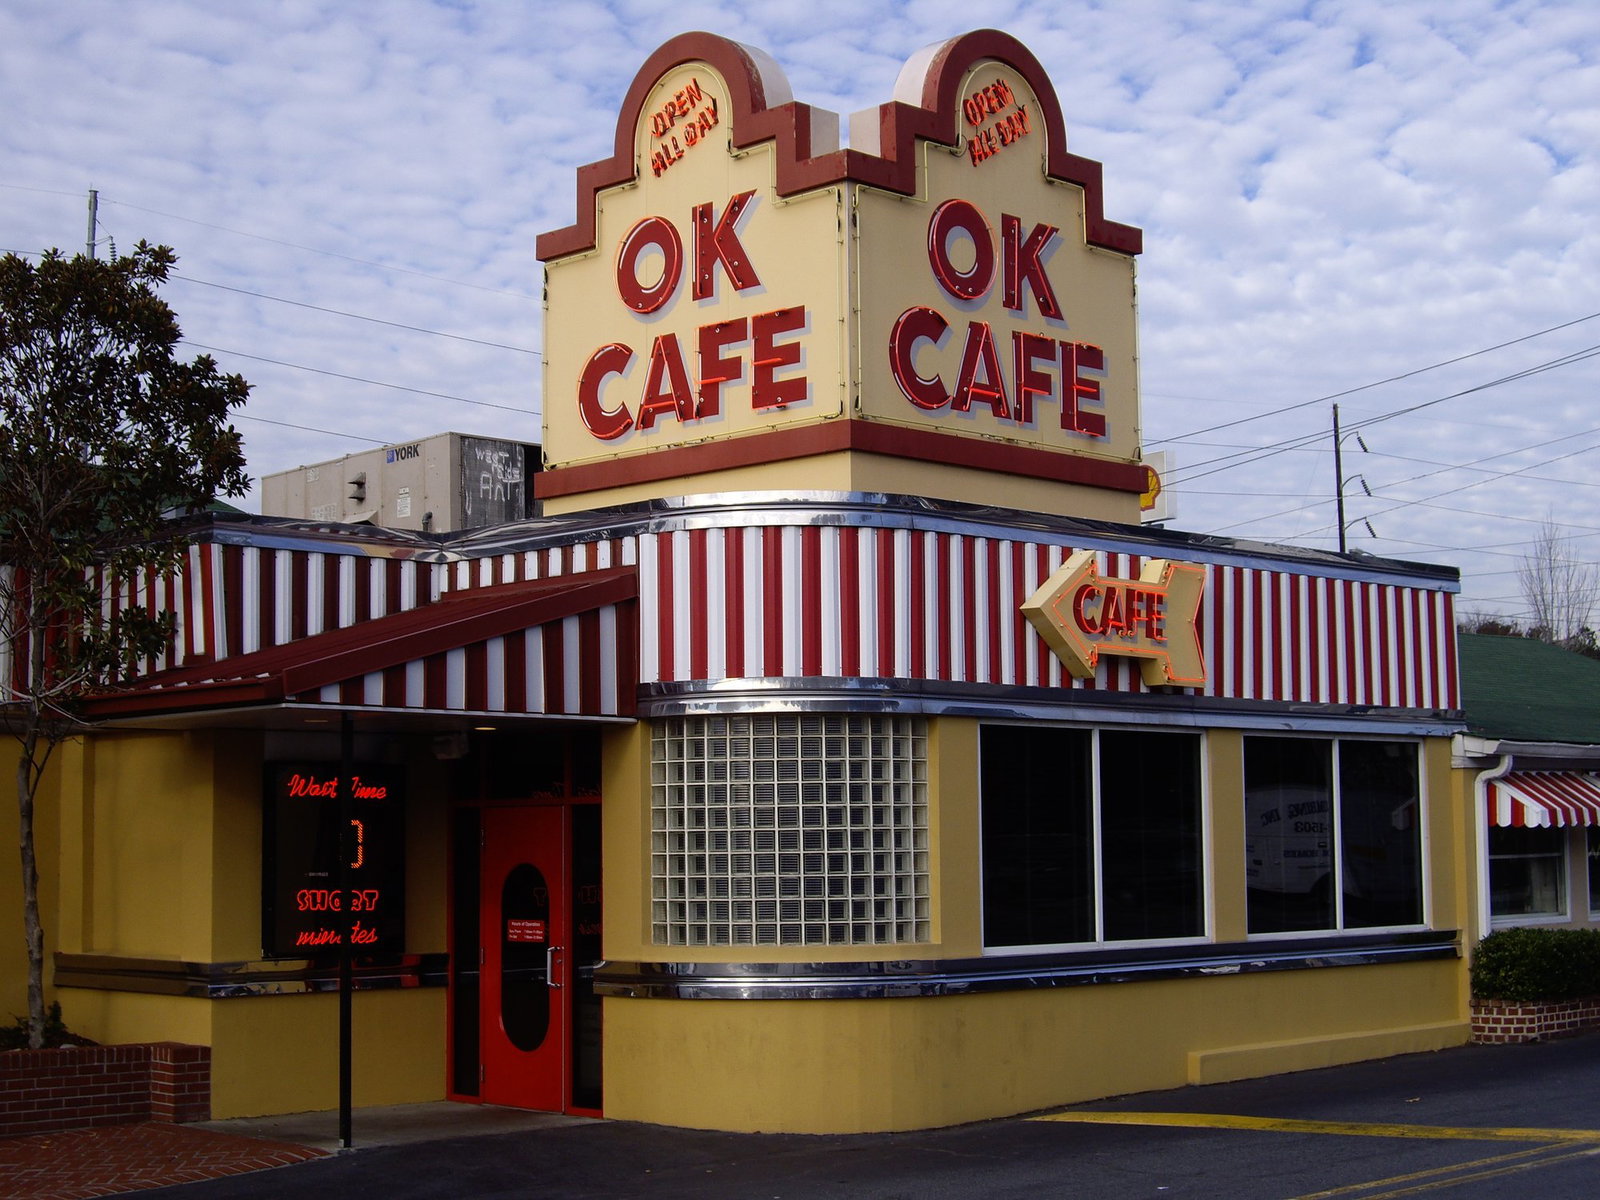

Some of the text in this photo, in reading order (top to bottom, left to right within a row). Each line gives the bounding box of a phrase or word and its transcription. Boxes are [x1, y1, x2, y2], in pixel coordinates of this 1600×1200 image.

[647, 78, 702, 138] OPEN
[963, 79, 1014, 127] OPEN
[651, 99, 719, 178] ALL DAY
[968, 105, 1032, 167] ALL DAY
[614, 188, 761, 314] OK
[928, 199, 1064, 321] OK
[577, 305, 808, 440] CAFE
[889, 306, 1106, 437] CAFE
[395, 444, 419, 461] YORK
[1073, 584, 1168, 641] CAFE
[288, 774, 338, 799] Wait
